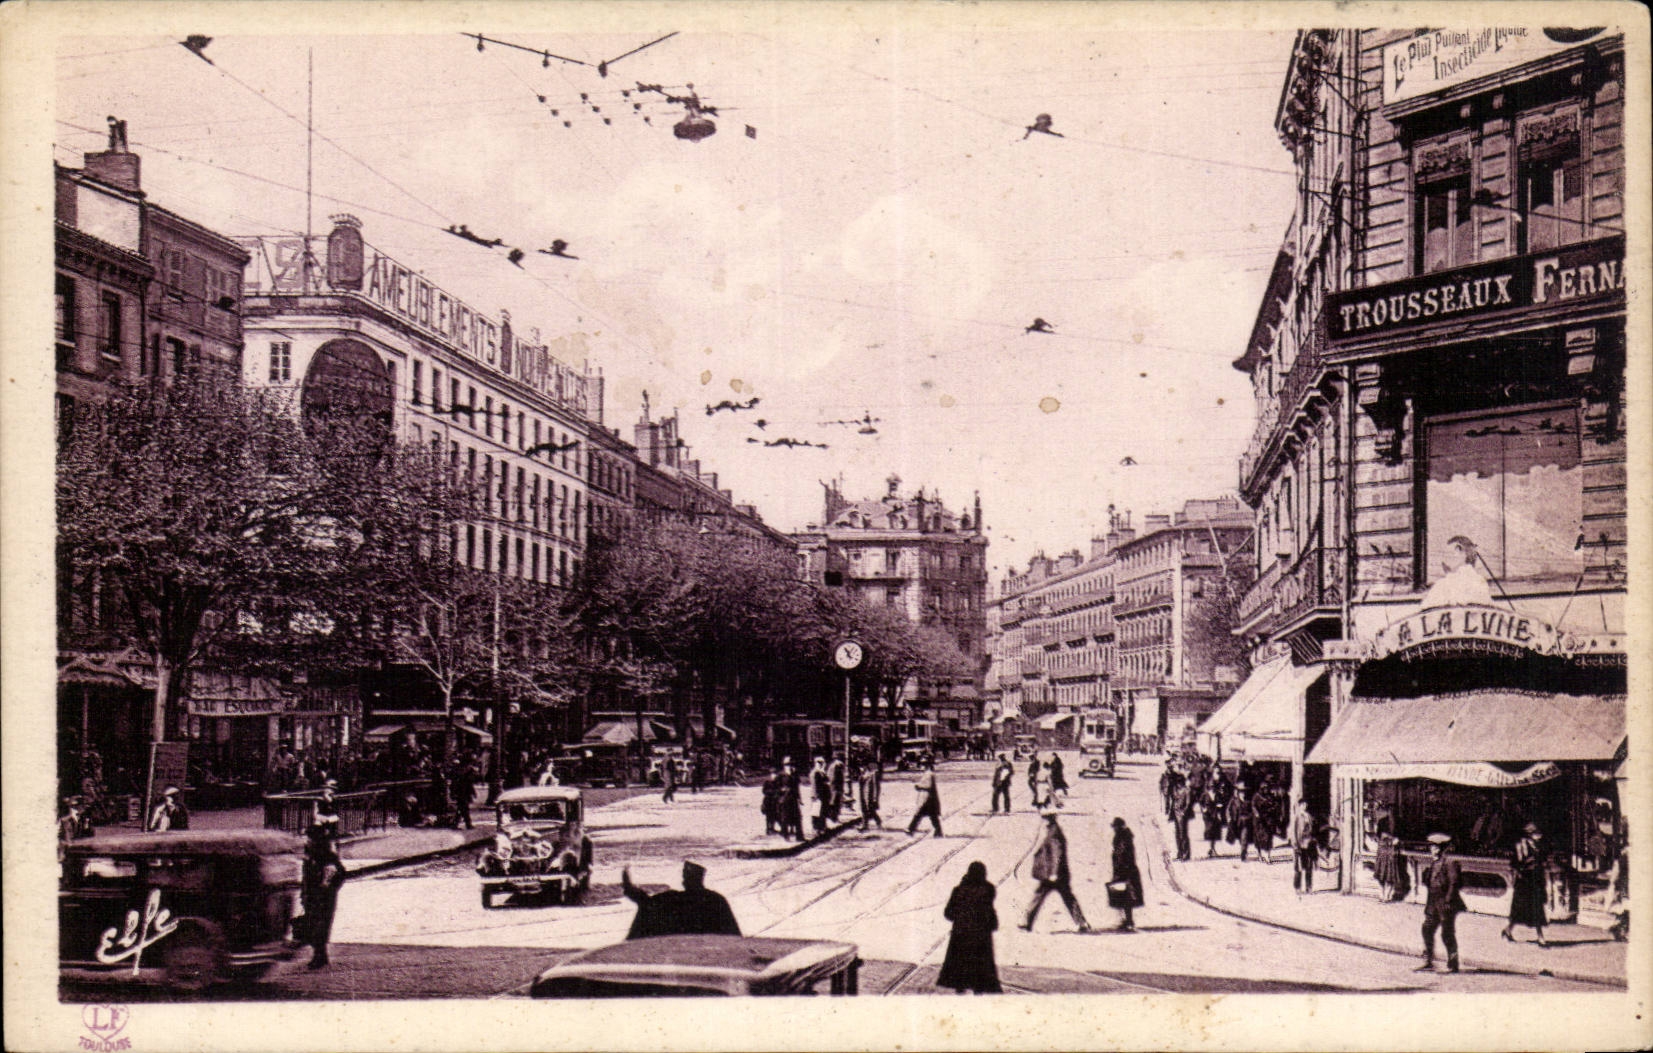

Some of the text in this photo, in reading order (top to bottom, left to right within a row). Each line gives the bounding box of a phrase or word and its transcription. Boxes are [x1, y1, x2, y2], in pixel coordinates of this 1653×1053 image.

[1393, 54, 1406, 92] Le
[369, 253, 496, 365] AMEUBLEMENTS
[1340, 274, 1513, 332] TROUSSEAUX
[1421, 611, 1453, 638] LA
